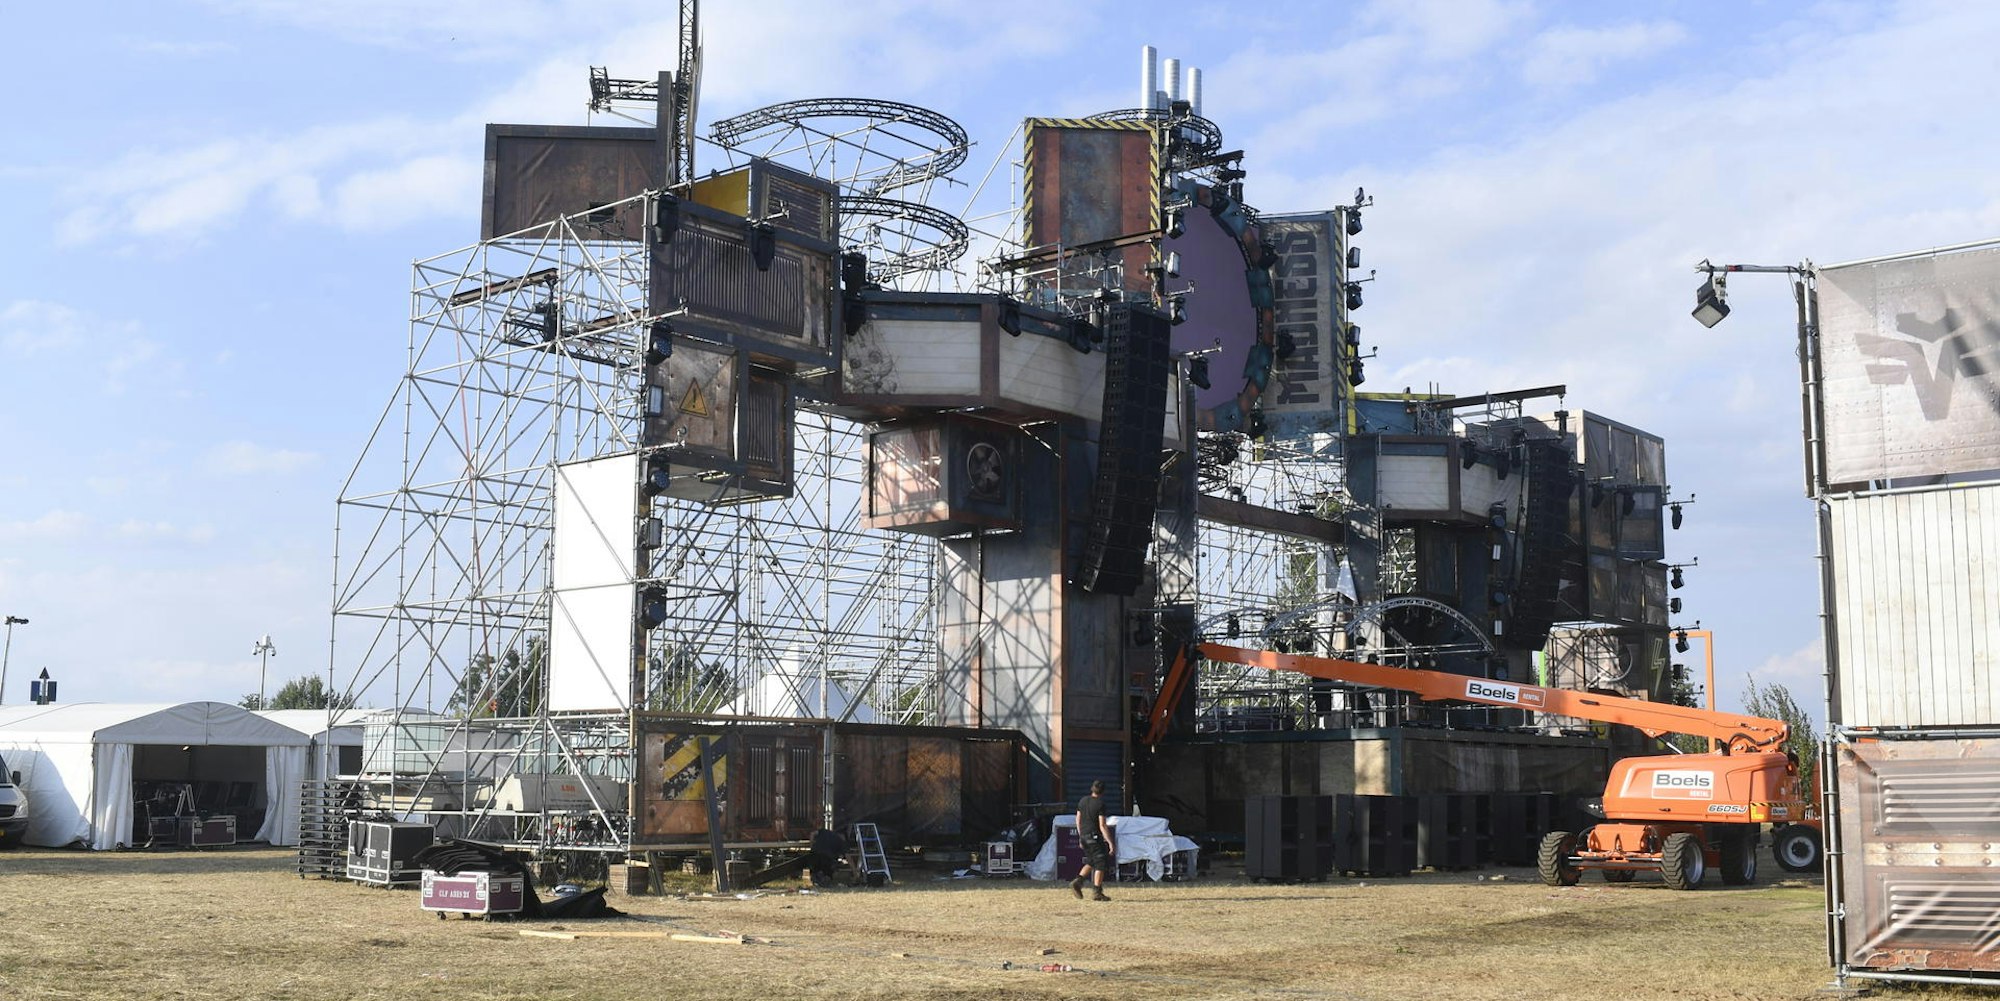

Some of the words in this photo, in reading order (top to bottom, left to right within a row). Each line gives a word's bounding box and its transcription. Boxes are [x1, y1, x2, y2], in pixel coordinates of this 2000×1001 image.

[1275, 231, 1319, 405] MADNESS
[1469, 683, 1516, 700] Boels
[1656, 774, 1710, 787] Boels
[1708, 804, 1747, 813] 660SJ
